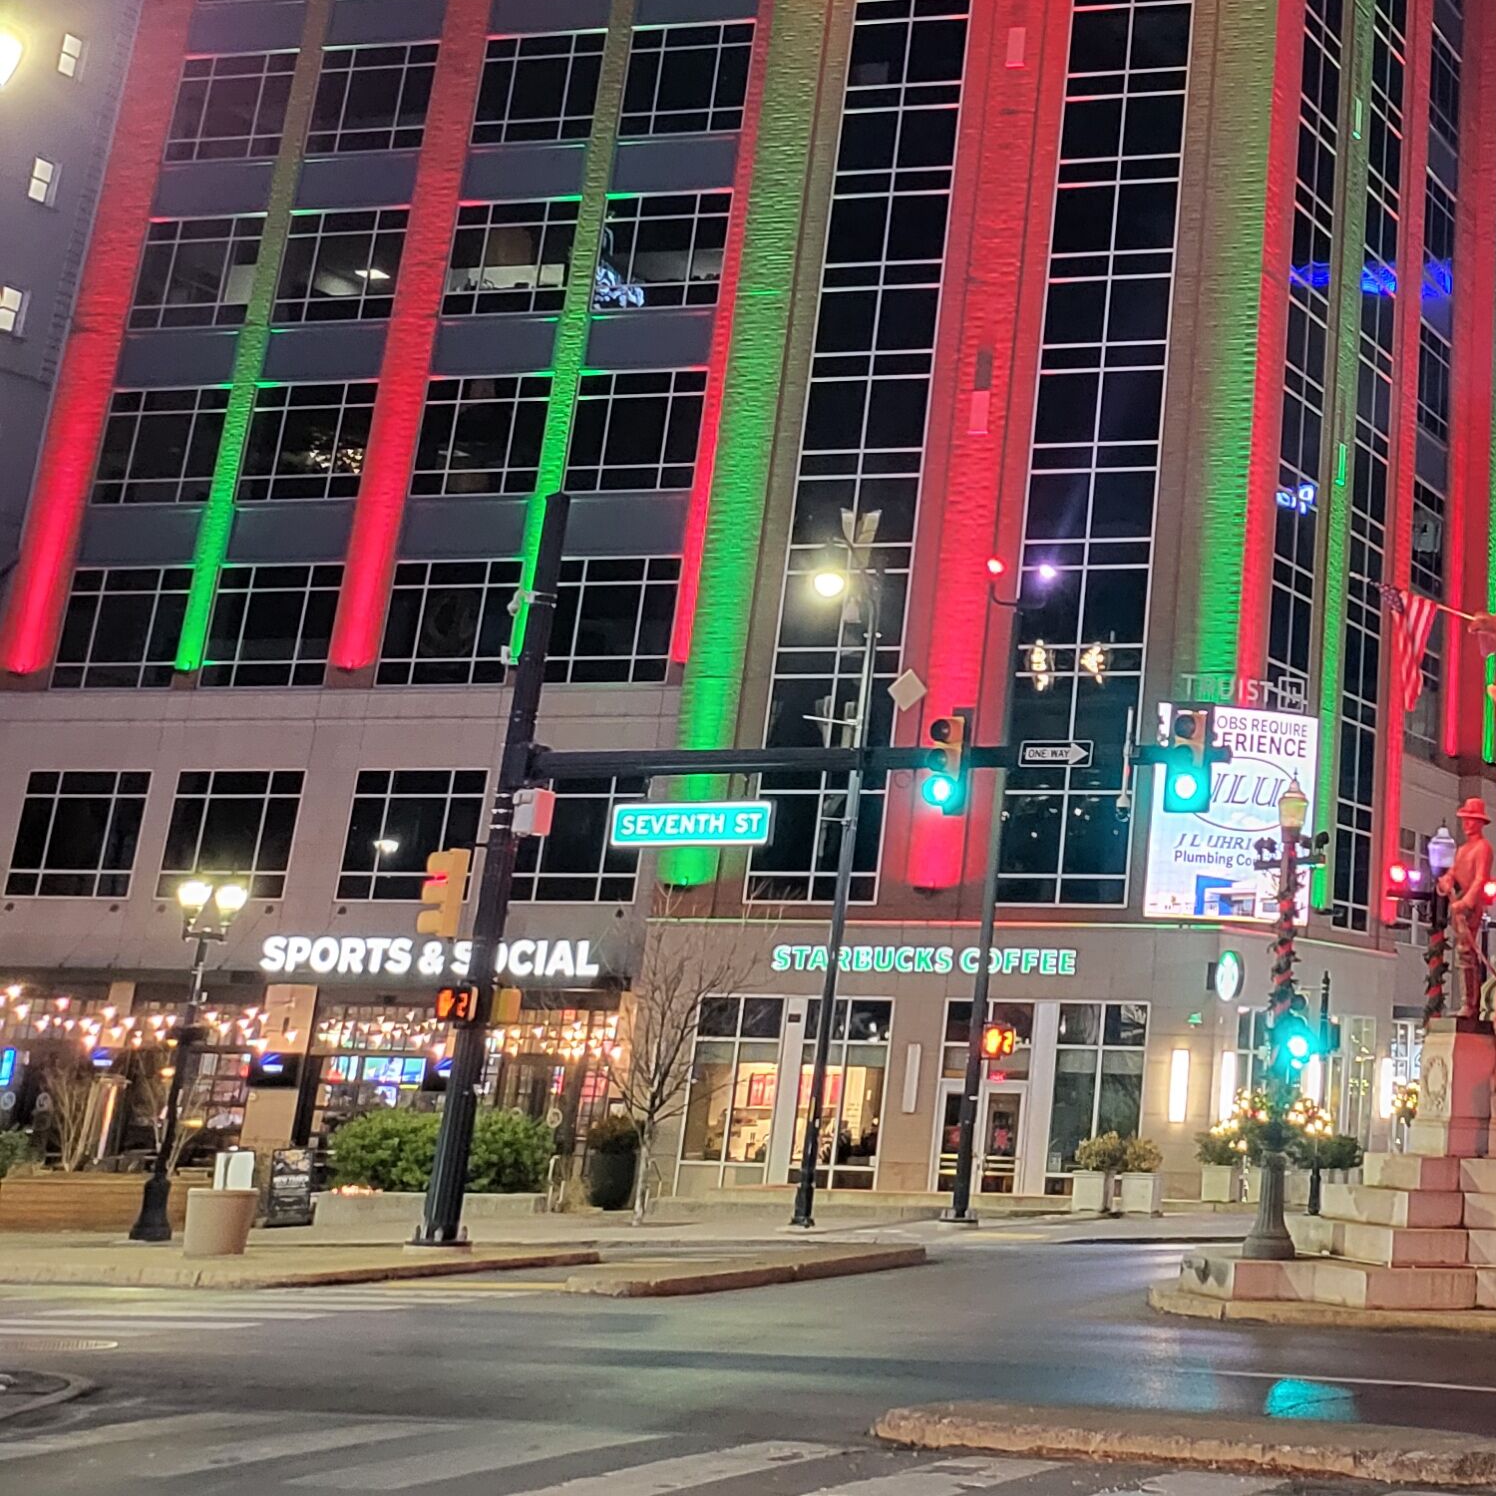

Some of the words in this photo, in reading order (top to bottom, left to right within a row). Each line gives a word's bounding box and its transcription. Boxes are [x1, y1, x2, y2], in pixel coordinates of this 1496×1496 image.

[1181, 673, 1274, 709] TRUIST
[1217, 715, 1248, 731] OBS
[1251, 718, 1308, 738] REQUIRE
[1028, 749, 1047, 759] ONE
[1050, 749, 1069, 759] WAY
[1222, 732, 1307, 758] ERIENCE
[620, 813, 725, 835] SEVENTH
[734, 812, 762, 834] ST
[1173, 833, 1187, 849] J
[1190, 834, 1201, 848] L
[1207, 834, 1252, 851] UHRI
[1174, 849, 1234, 869] Plumbing
[1236, 853, 1253, 866] Co
[259, 935, 413, 974] SPORTS
[417, 939, 445, 976] &
[449, 938, 600, 977] SCIAL
[771, 944, 954, 974] STARBUCKS
